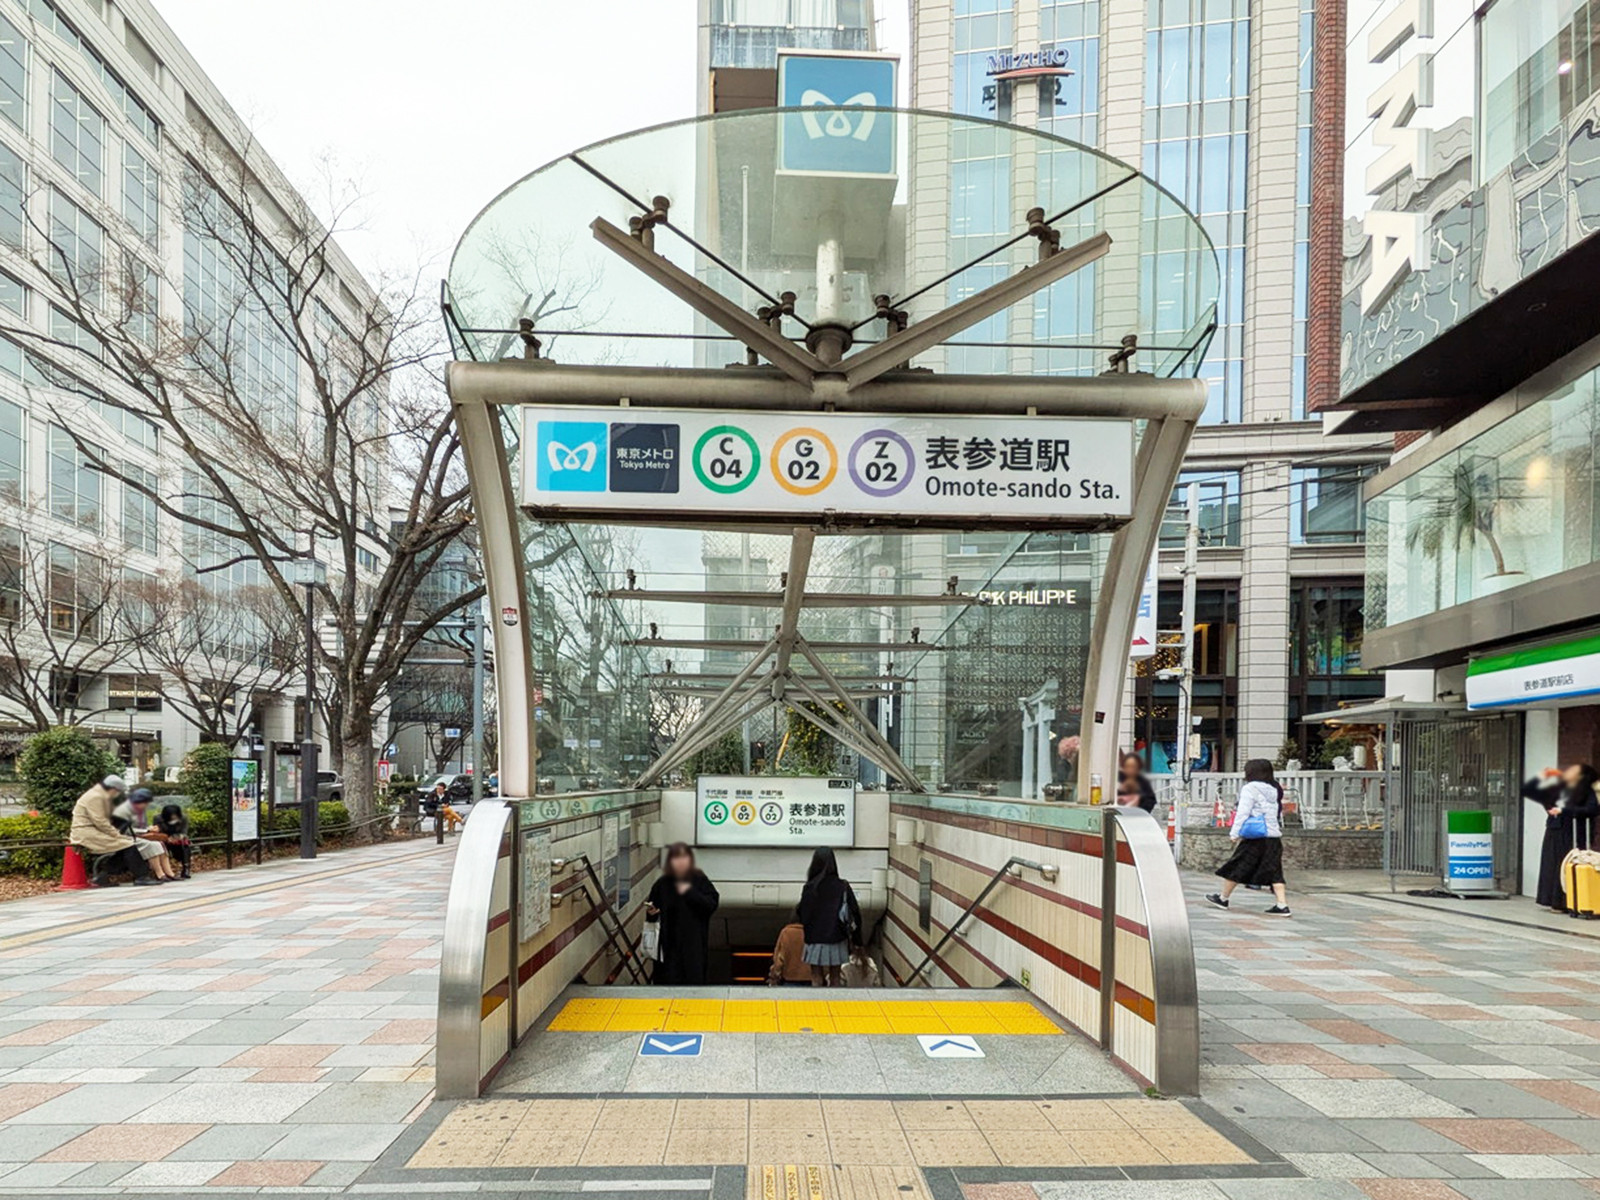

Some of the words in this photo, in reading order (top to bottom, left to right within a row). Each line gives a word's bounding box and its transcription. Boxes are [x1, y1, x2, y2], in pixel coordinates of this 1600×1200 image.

[986, 48, 1069, 72] MIZUHO
[616, 448, 674, 460] 東京メトロ
[719, 437, 733, 455] C
[795, 439, 813, 457] G
[874, 441, 889, 458] Z
[925, 436, 1070, 472] 表参道駅
[620, 460, 643, 470] Tokyo
[645, 461, 670, 469] Metro
[710, 458, 742, 478] 04
[788, 460, 820, 480] 02
[865, 462, 897, 482] 02
[925, 476, 1071, 498] Omote-sando
[1080, 479, 1119, 499] Sta.
[1009, 590, 1076, 605] PHILIPPE
[710, 812, 722, 820] 04
[737, 812, 750, 820] 02
[765, 813, 777, 821] 02
[789, 803, 845, 817] 表参道駅
[789, 817, 846, 826] Omote-sando
[789, 826, 805, 834] Sta.
